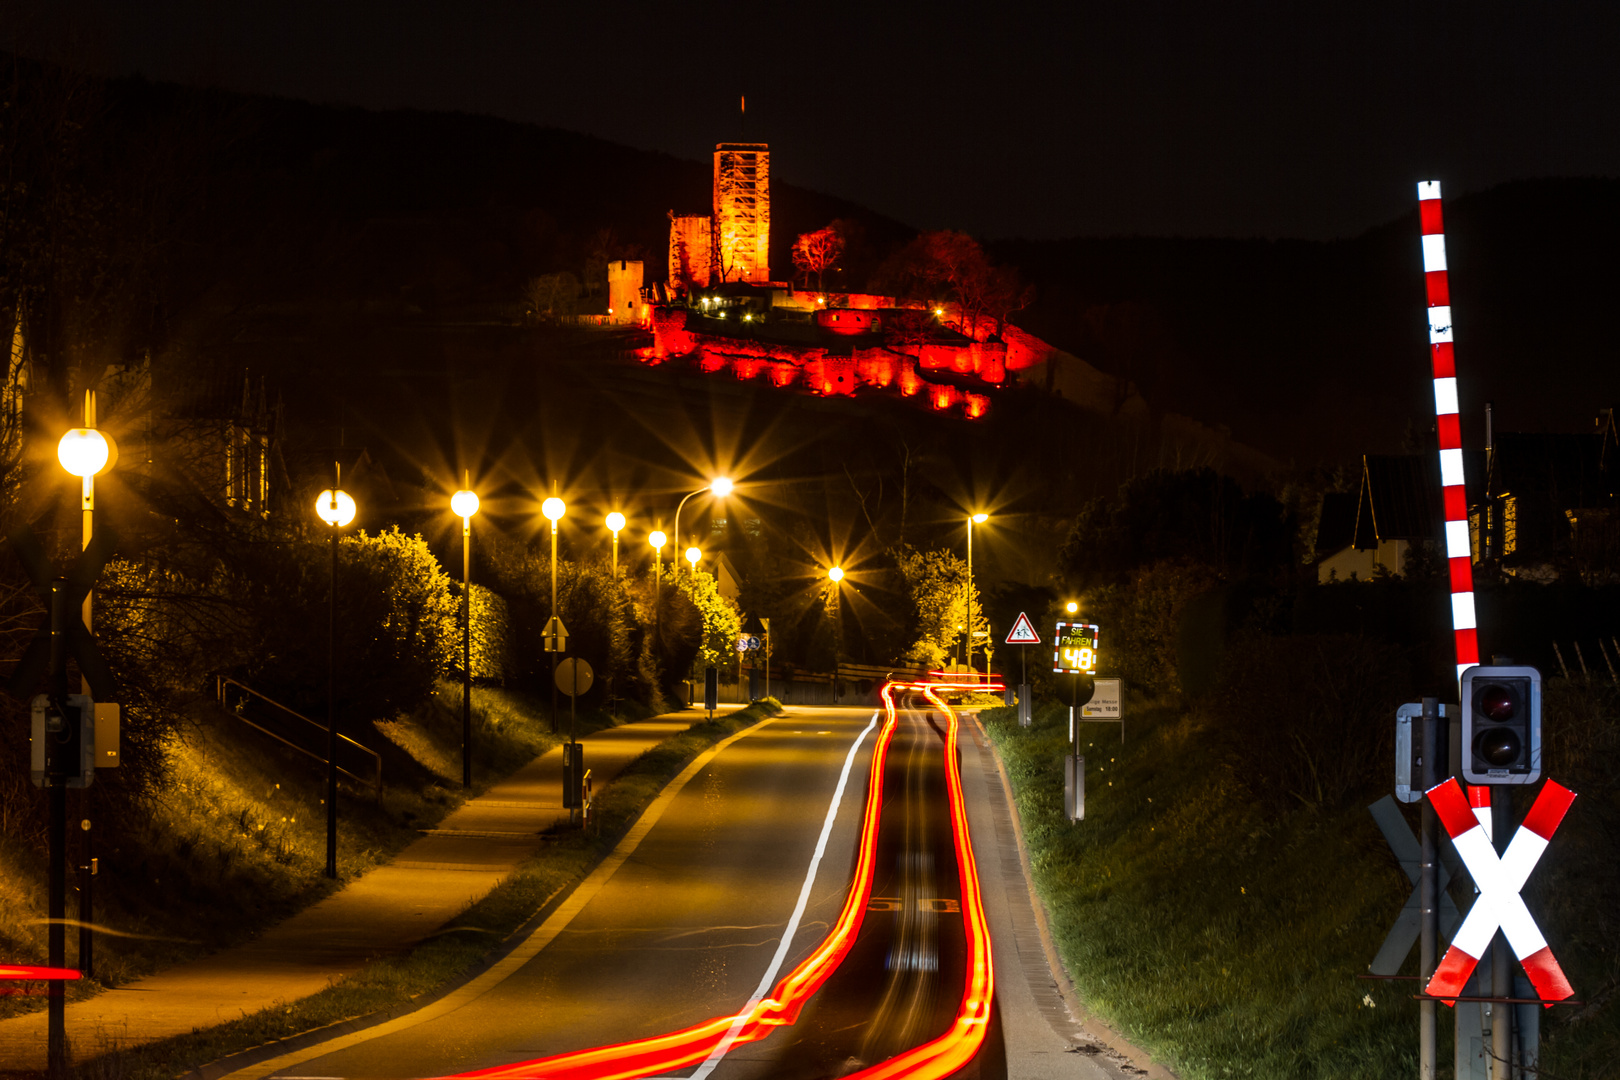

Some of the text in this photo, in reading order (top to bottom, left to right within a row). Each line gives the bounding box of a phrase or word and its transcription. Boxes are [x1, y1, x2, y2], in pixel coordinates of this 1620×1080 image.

[1071, 628, 1084, 636] SIE
[1061, 636, 1092, 646] FAHREN
[1065, 648, 1092, 669] 48
